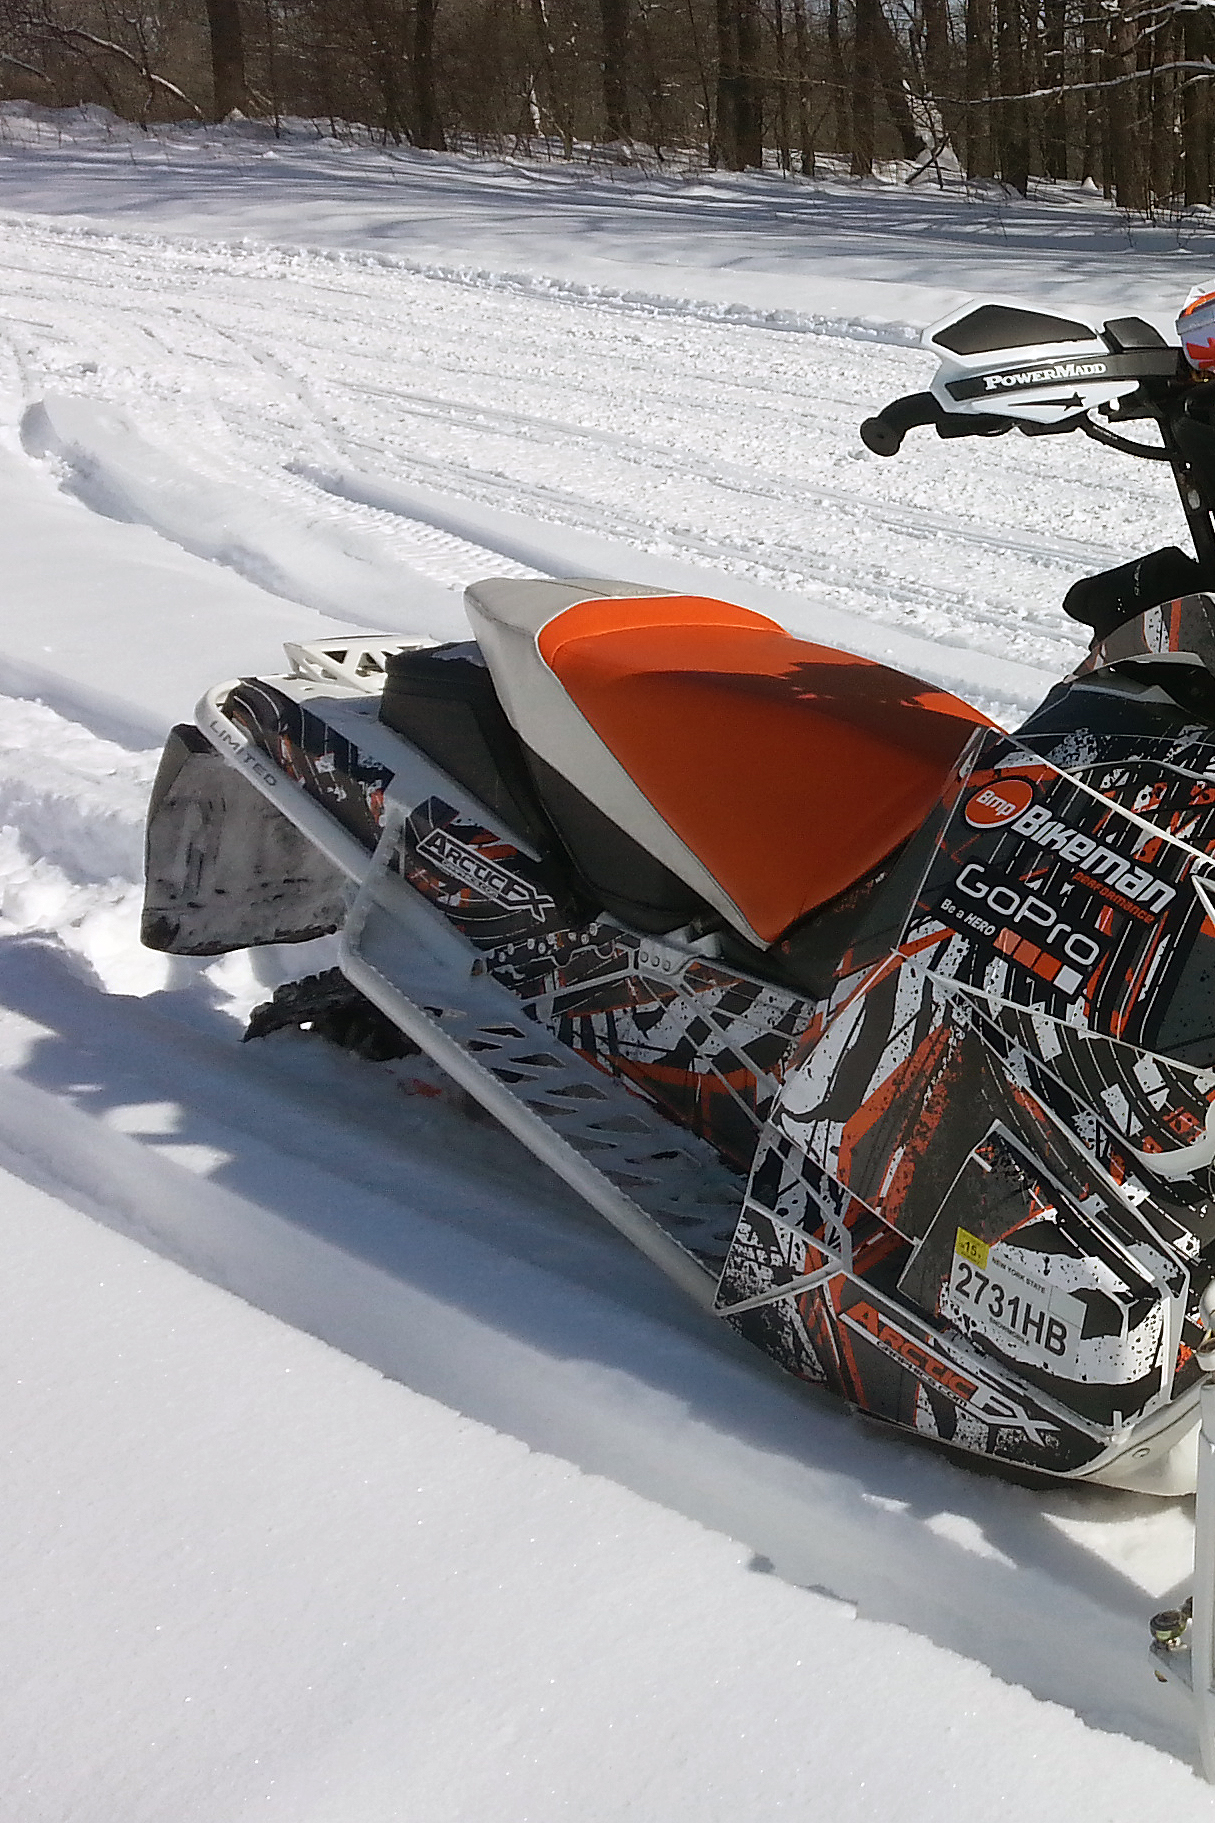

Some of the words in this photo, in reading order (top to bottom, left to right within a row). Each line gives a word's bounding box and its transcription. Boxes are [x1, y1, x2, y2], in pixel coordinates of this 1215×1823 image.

[209, 720, 277, 786] LIMITED
[940, 898, 956, 914] Be
[956, 910, 965, 919] a
[964, 912, 996, 936] HERO
[955, 1262, 1067, 1357] 2731HB
